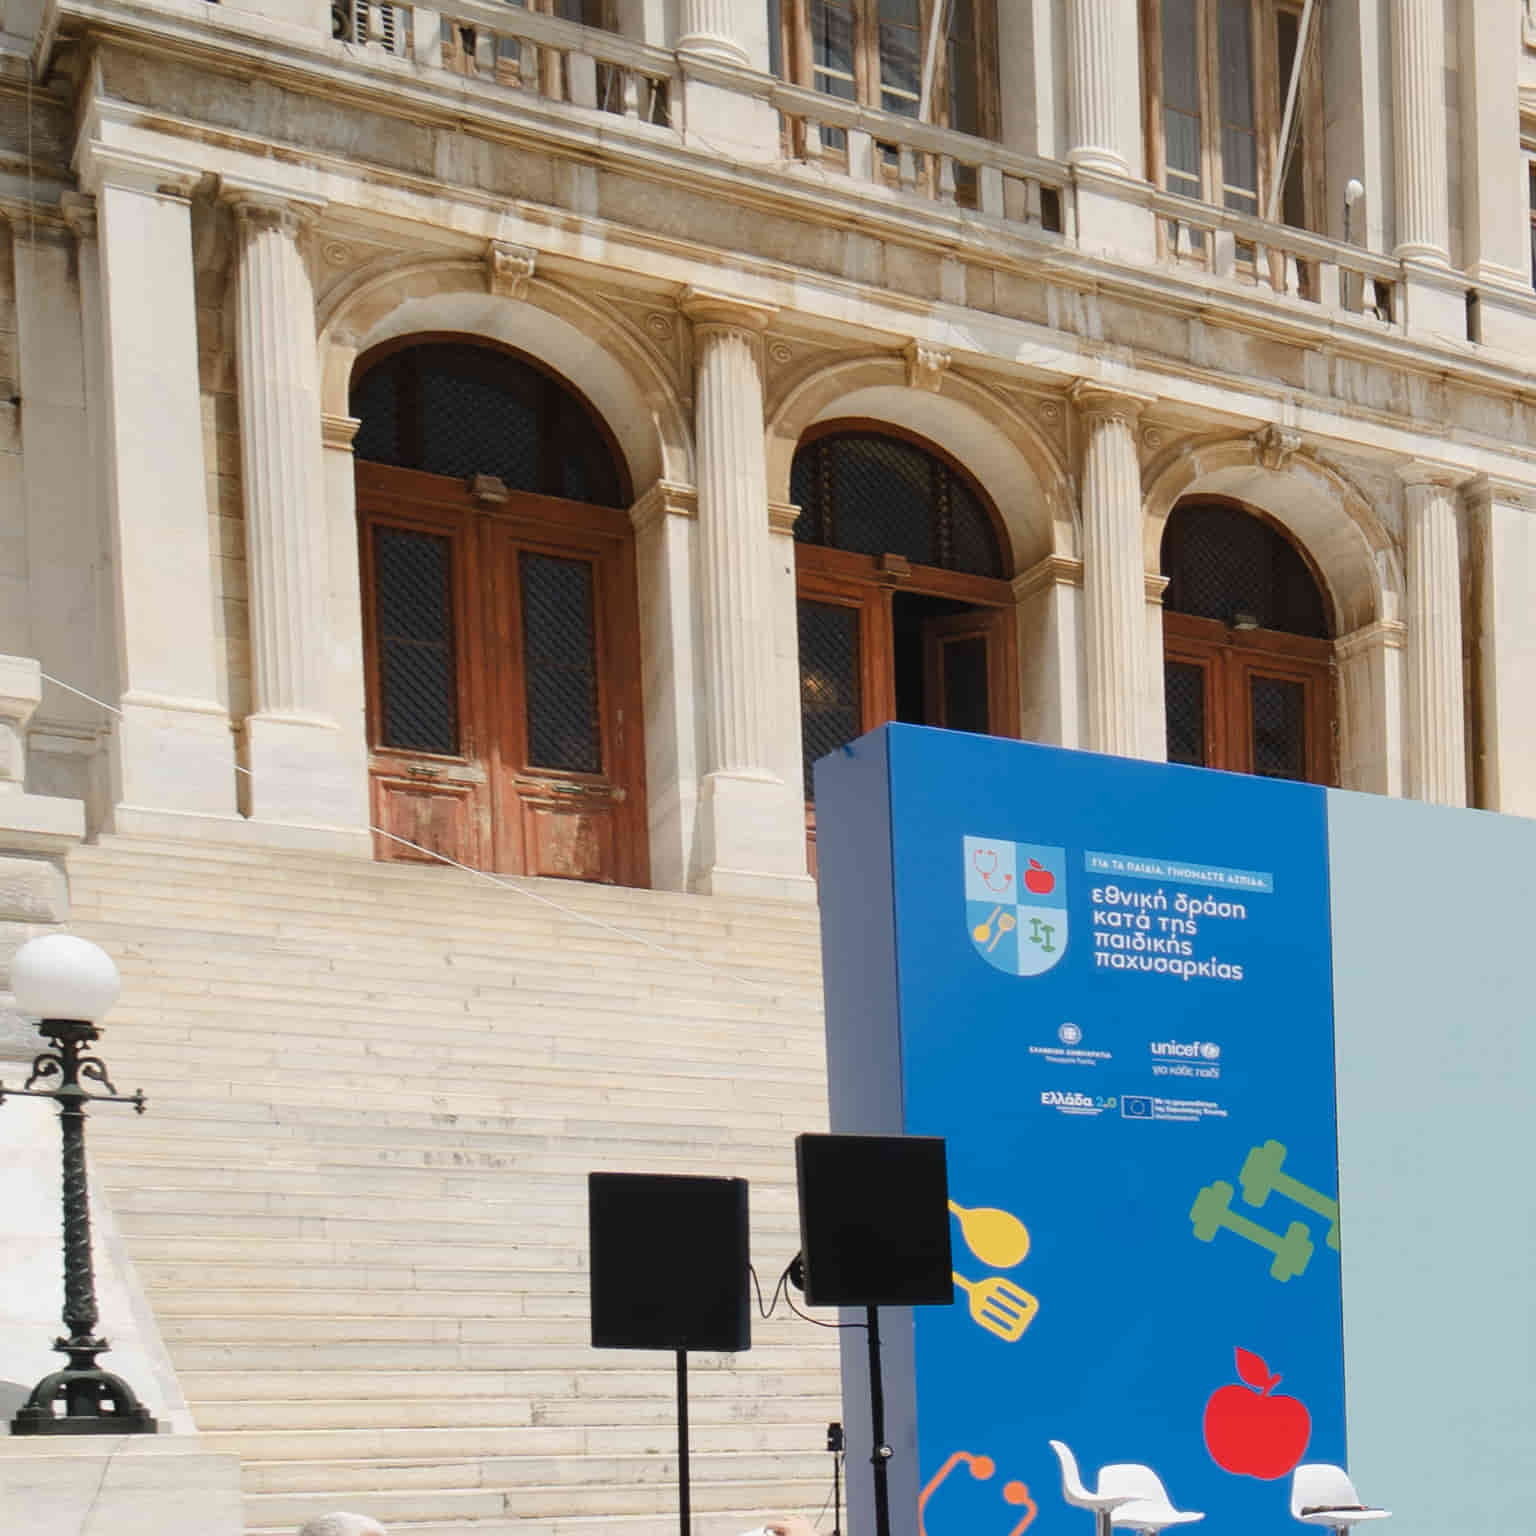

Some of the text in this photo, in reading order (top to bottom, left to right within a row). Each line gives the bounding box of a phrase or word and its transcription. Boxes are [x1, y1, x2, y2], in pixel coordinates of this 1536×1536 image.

[1112, 860, 1124, 871] ΤΑ
[1092, 885, 1247, 919] εθνική δράση
[1093, 909, 1198, 935] κατά της
[1093, 931, 1194, 956] παιδικής
[1094, 951, 1244, 981] παχυσαρκίας
[1151, 1040, 1201, 1057] unicef
[1041, 1091, 1093, 1107] Ελλάδα
